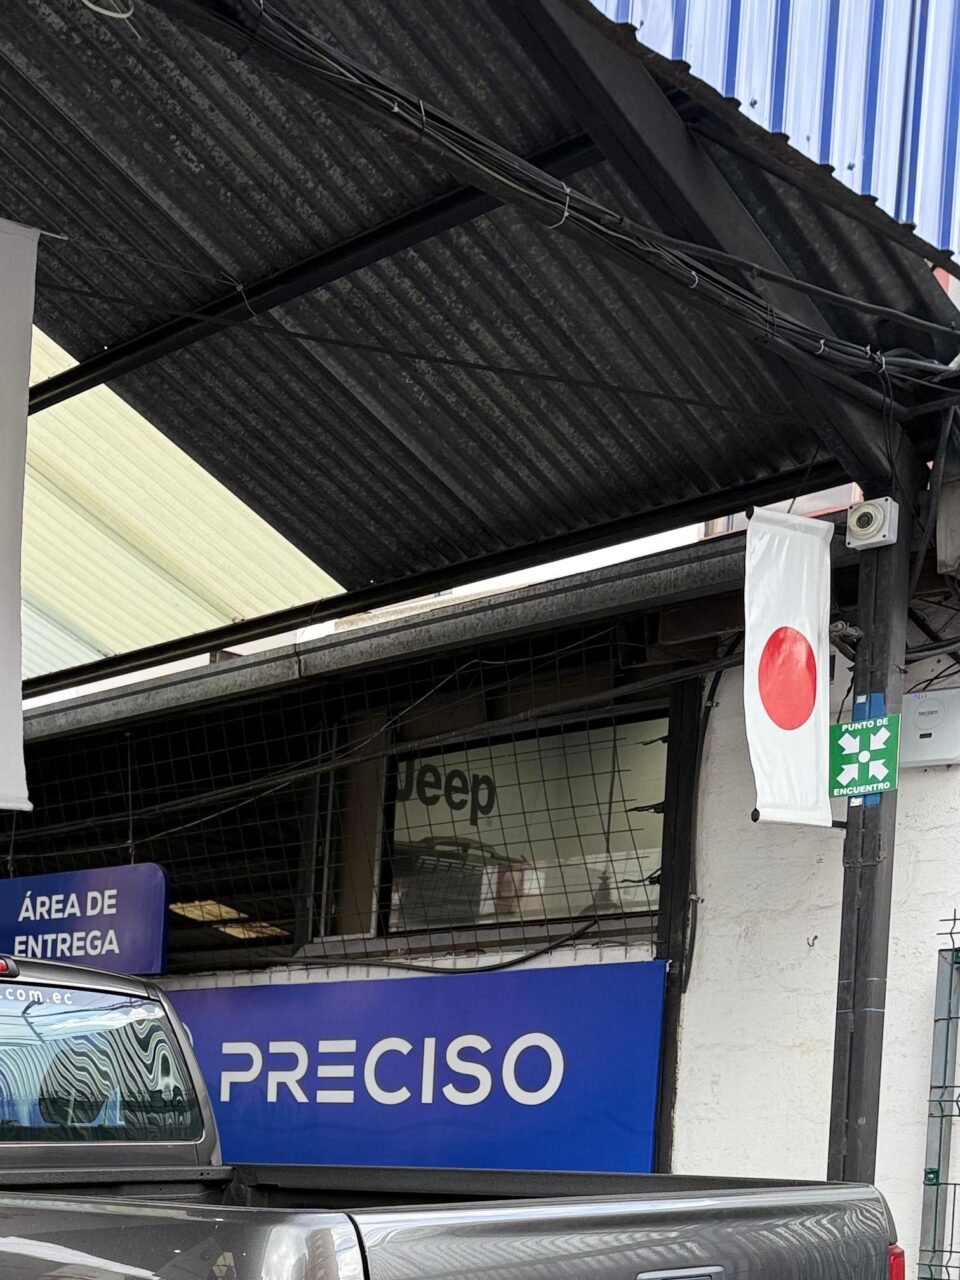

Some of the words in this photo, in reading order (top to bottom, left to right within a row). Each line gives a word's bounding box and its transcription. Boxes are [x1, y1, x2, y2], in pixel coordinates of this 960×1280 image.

[842, 720, 874, 732] PUNTO
[876, 717, 889, 727] DE
[396, 760, 496, 827] Jeep
[833, 781, 890, 797] ENCUENTRO
[18, 890, 81, 922] ÁREA
[86, 889, 118, 917] DE
[14, 929, 120, 959] ENTREGA
[220, 1032, 565, 1106] PRECISO
